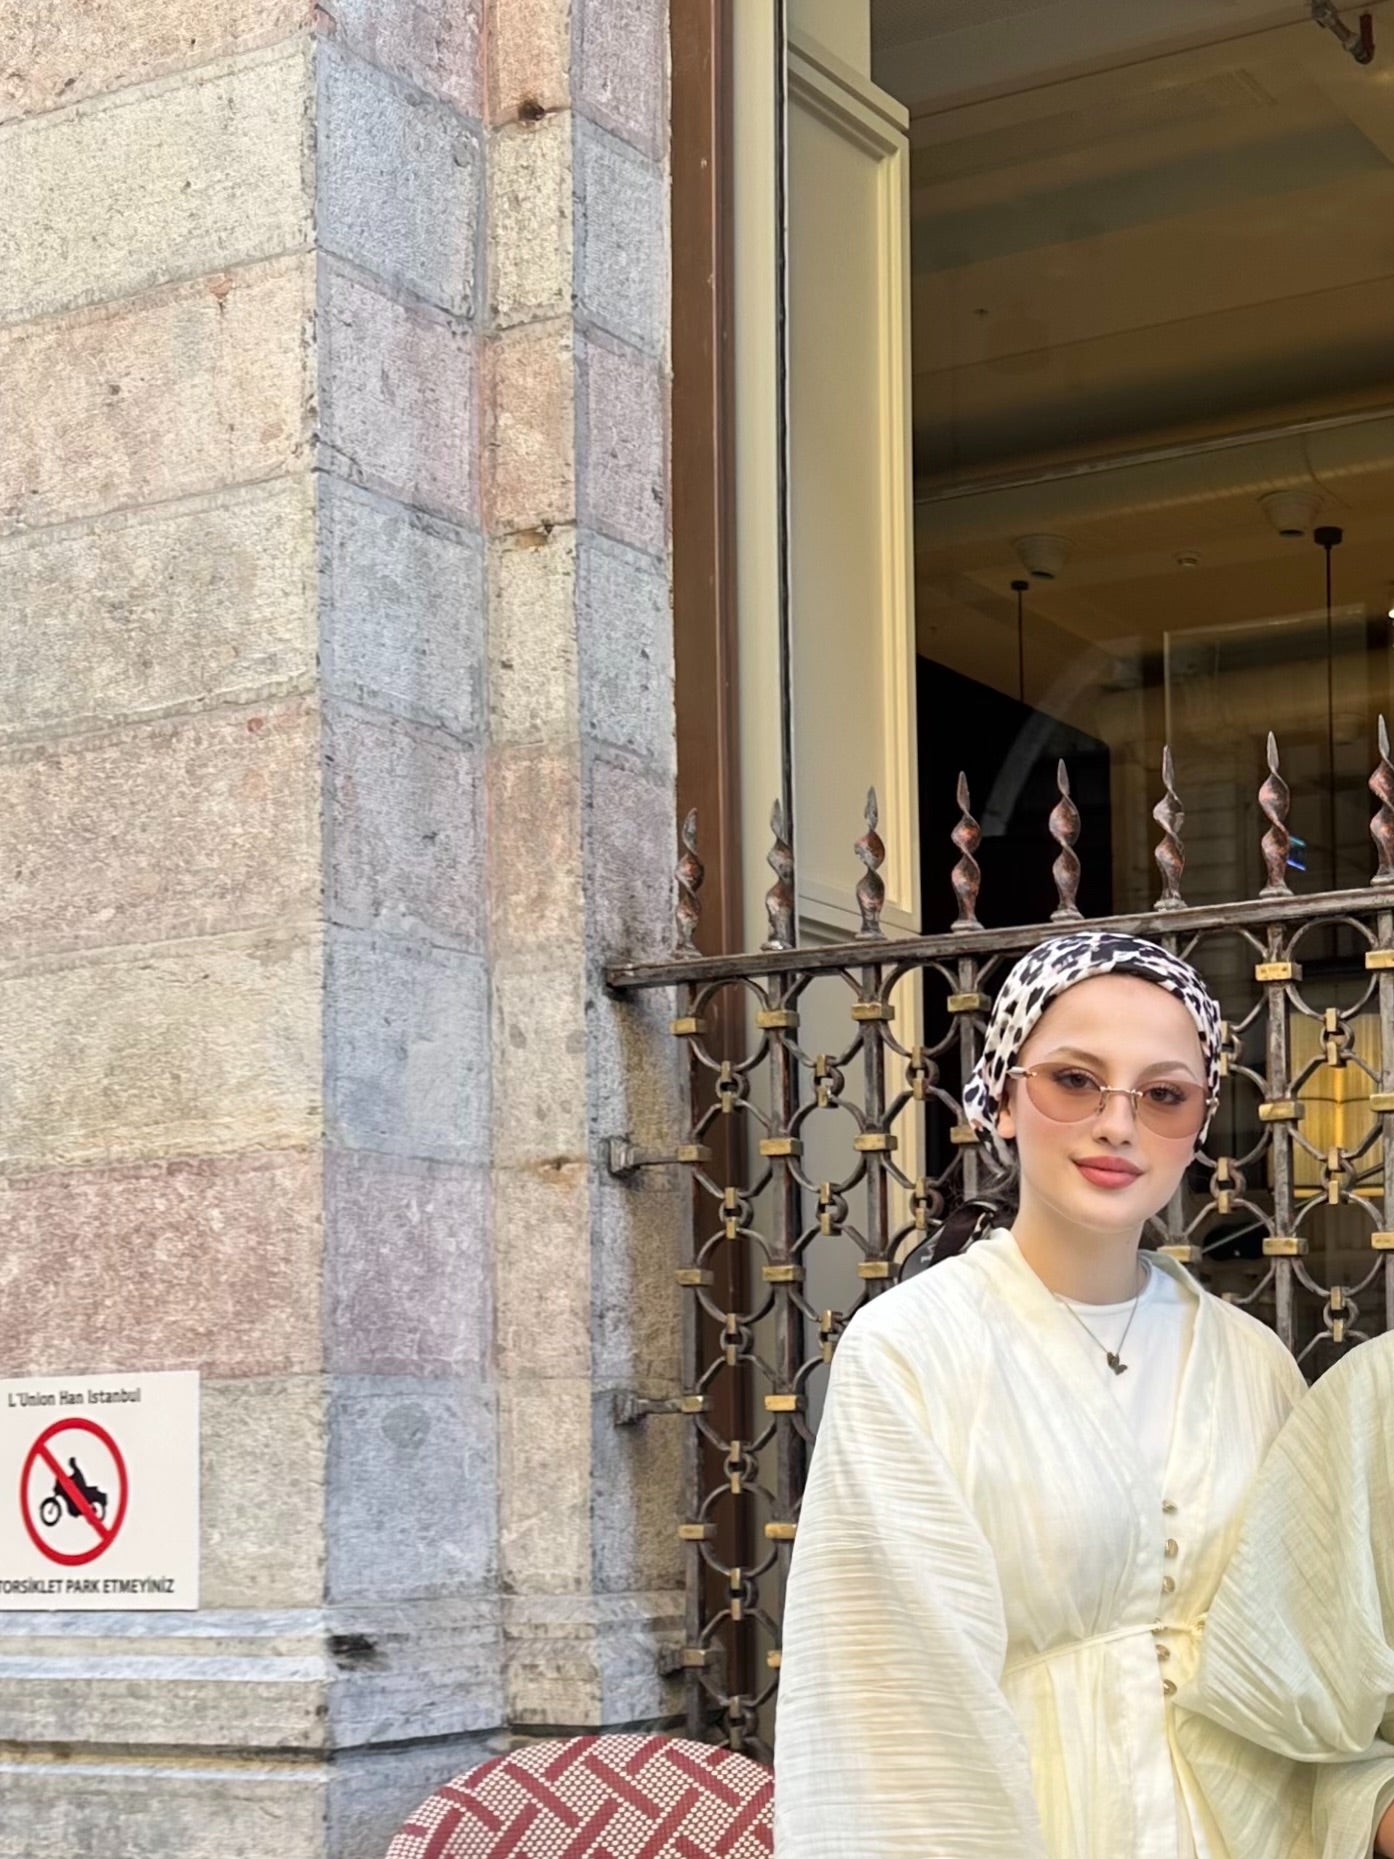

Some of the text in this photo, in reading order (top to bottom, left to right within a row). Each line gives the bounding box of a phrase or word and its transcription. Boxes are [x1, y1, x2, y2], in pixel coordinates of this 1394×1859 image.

[59, 1390, 84, 1404] Han
[66, 1579, 100, 1593] PARK
[103, 1576, 174, 1593] ETMEYİNİZ
